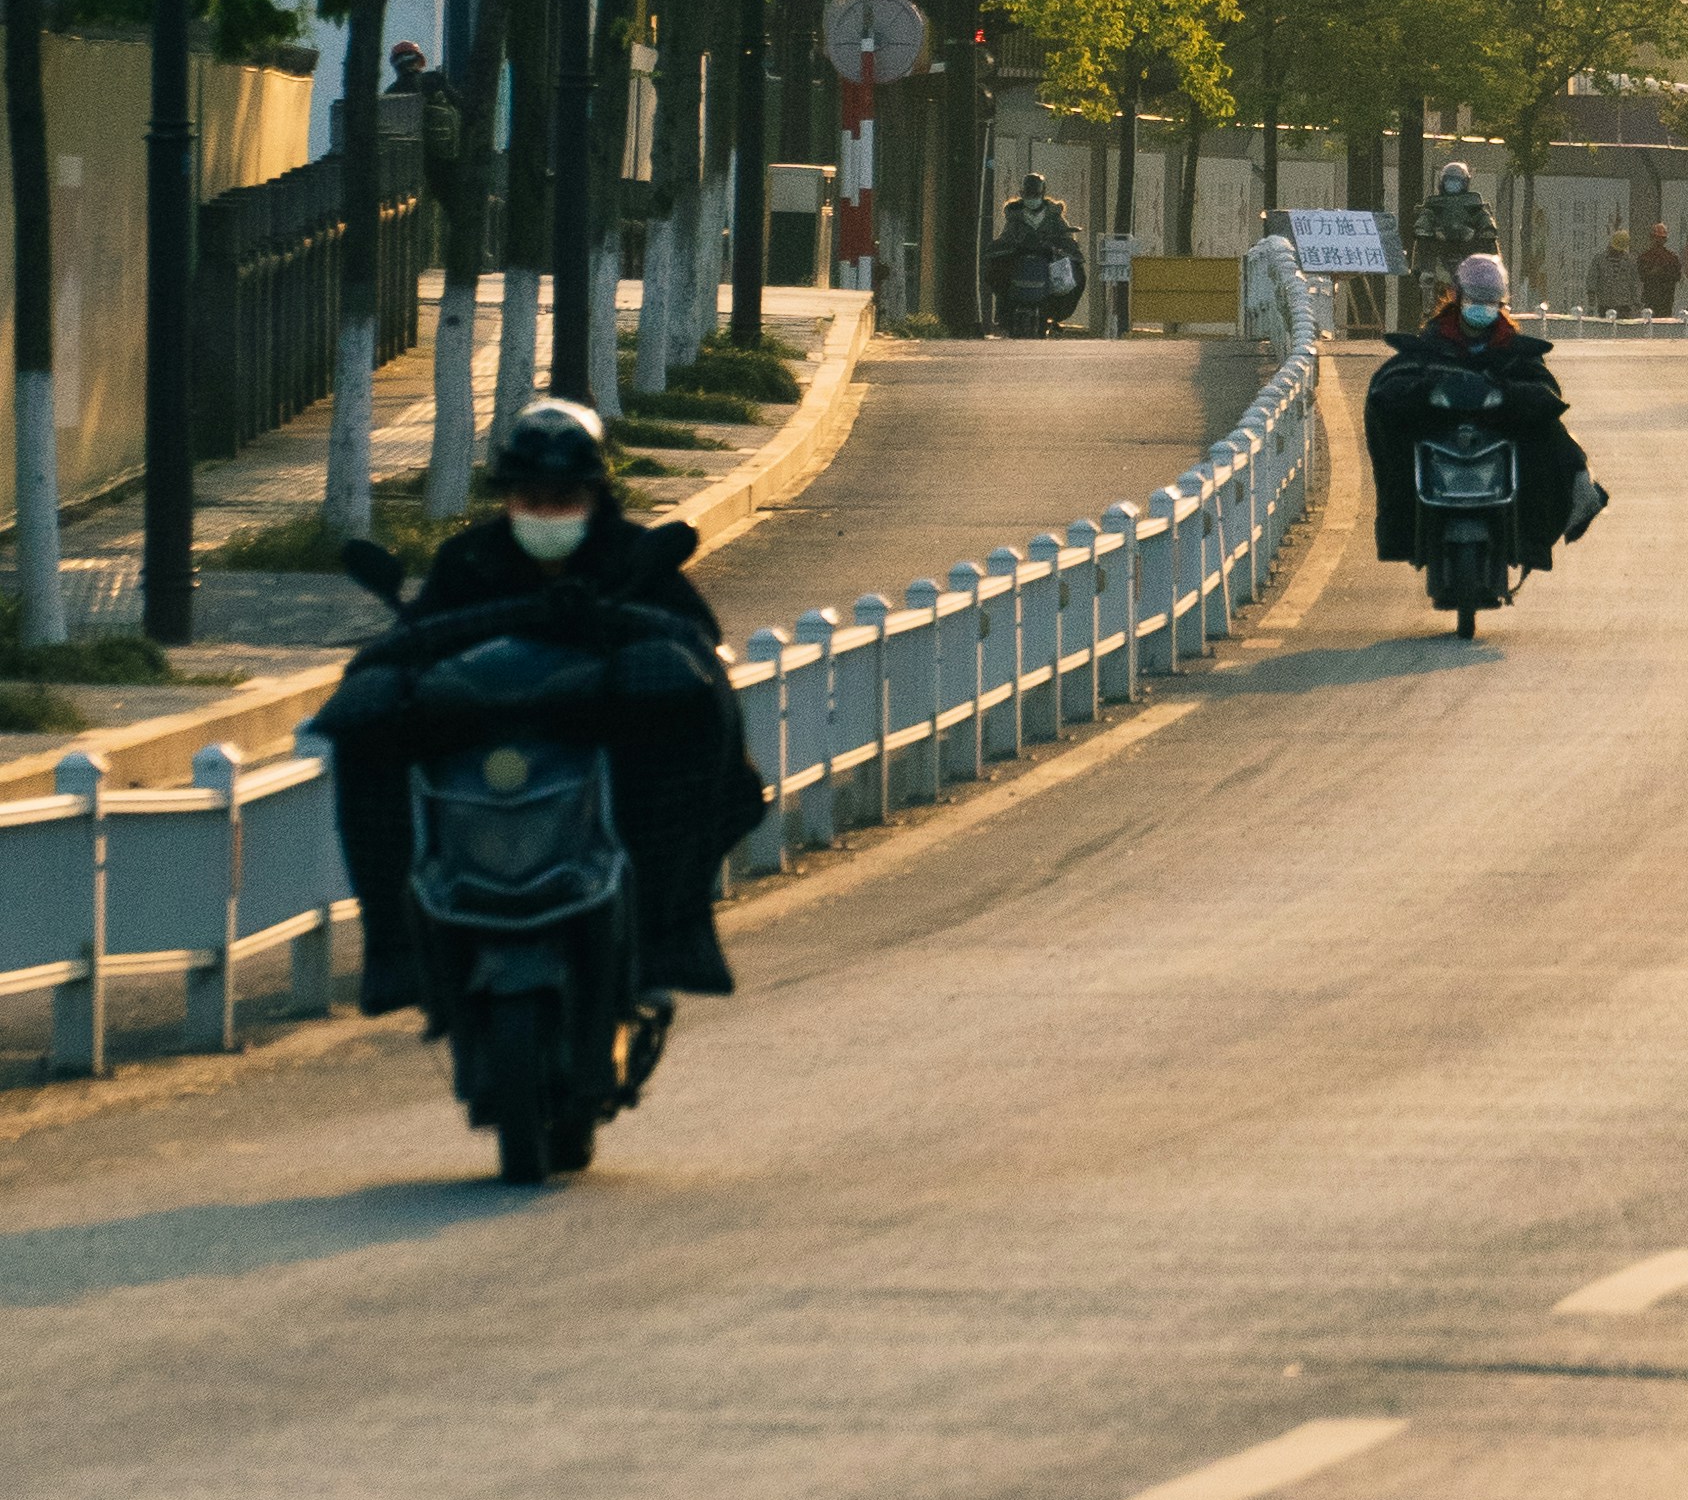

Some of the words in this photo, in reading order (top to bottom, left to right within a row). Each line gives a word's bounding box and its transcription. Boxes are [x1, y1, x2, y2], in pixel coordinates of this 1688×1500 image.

[1294, 216, 1377, 236] 前方施工
[1300, 245, 1385, 267] 道路封闭
